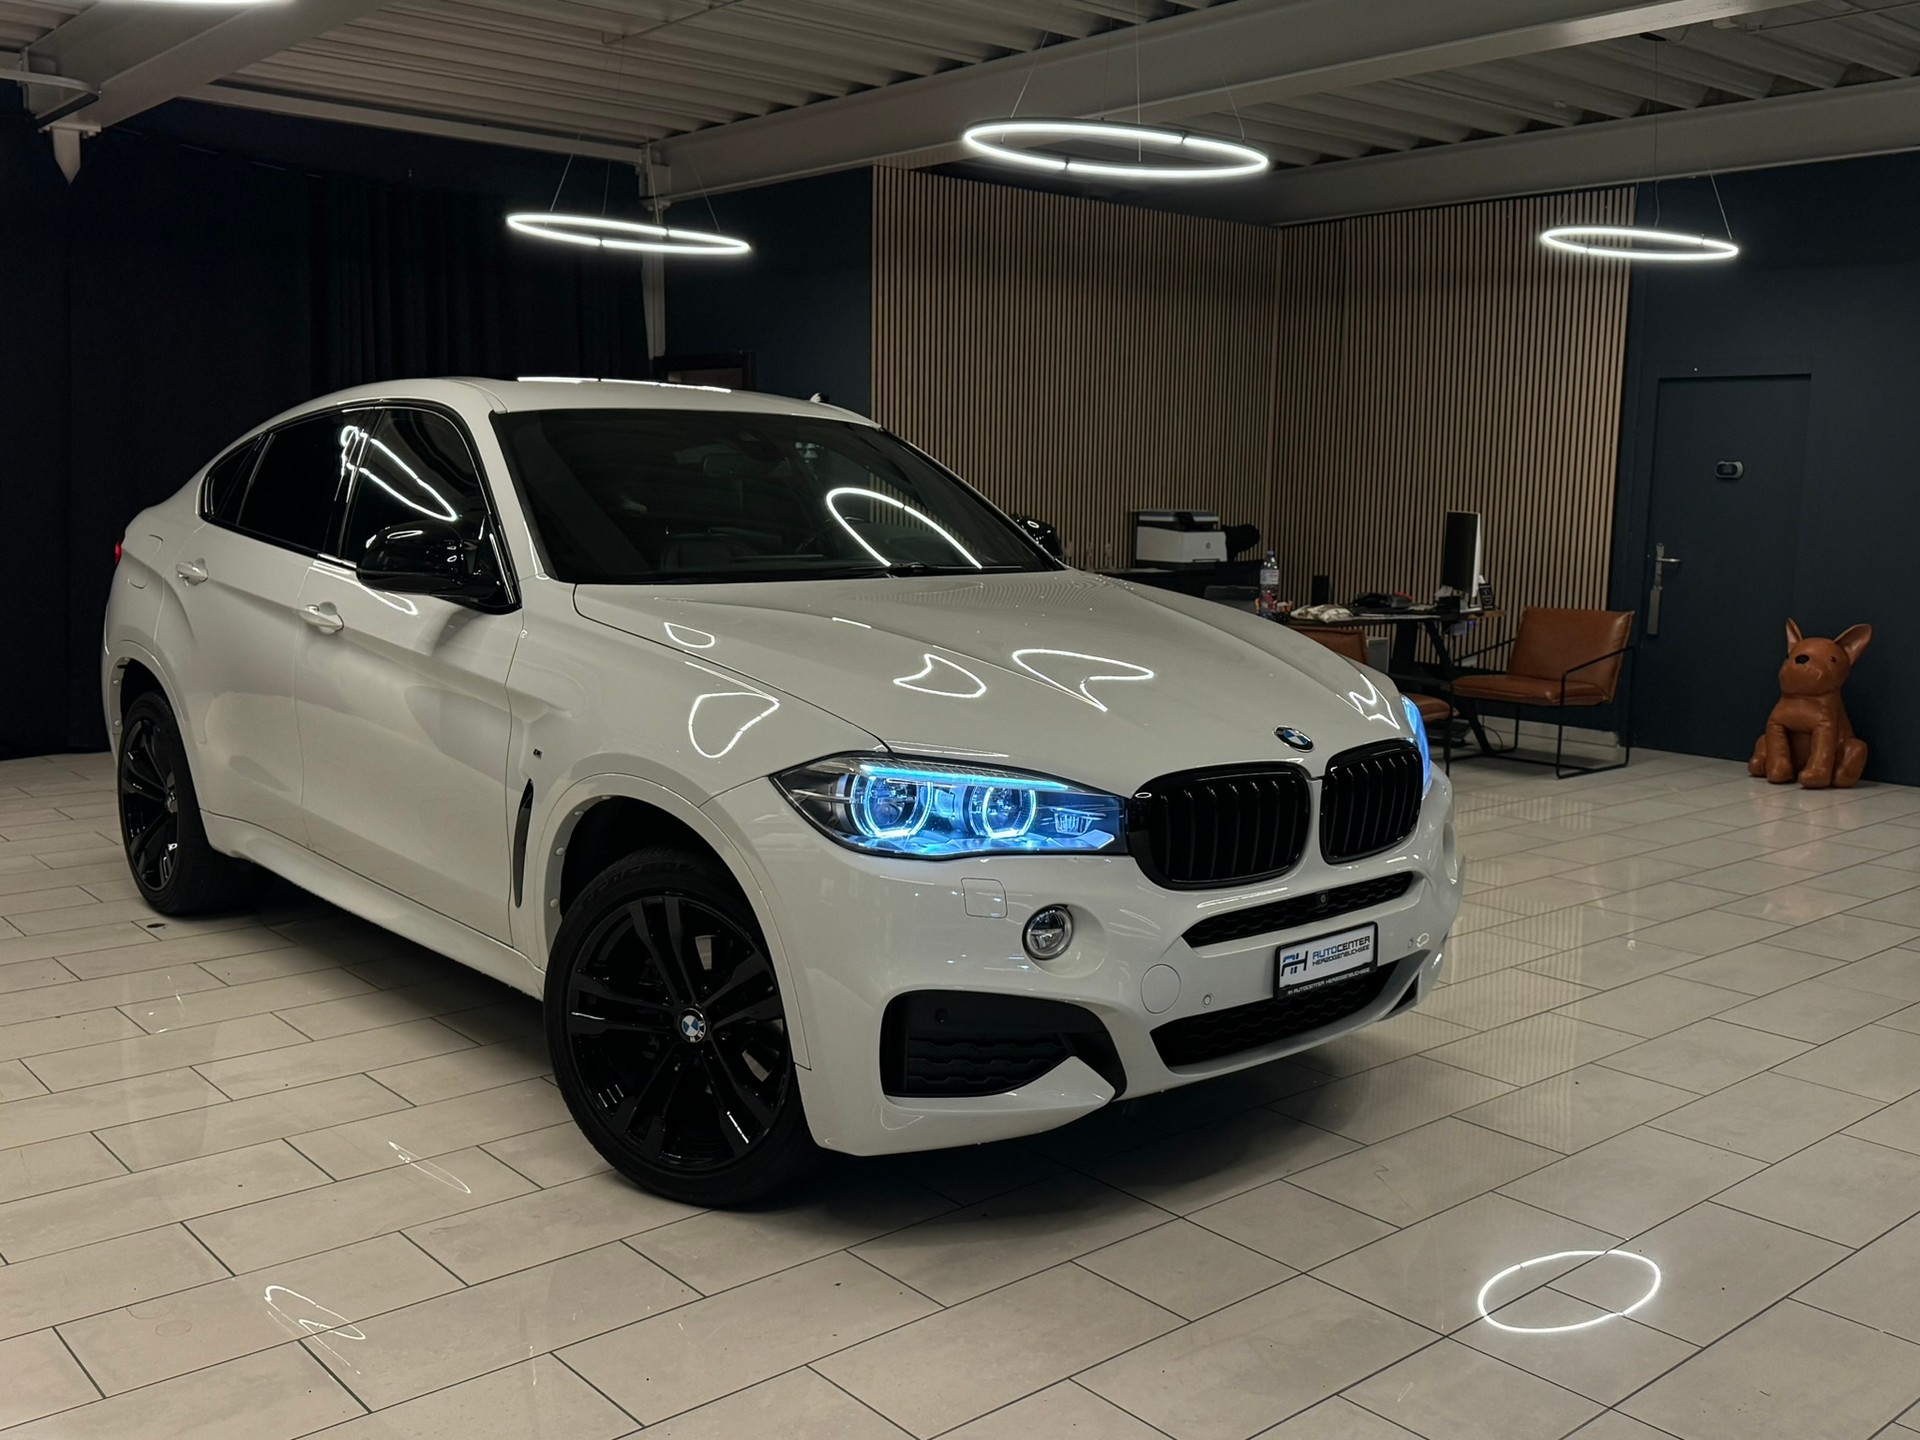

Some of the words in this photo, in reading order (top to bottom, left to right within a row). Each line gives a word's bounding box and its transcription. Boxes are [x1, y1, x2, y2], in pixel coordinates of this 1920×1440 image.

[1312, 935, 1370, 960] AUTOCENTER
[1312, 944, 1370, 966] HERZOGENBUCHSEE
[1293, 981, 1325, 994] AUTOCENTER
